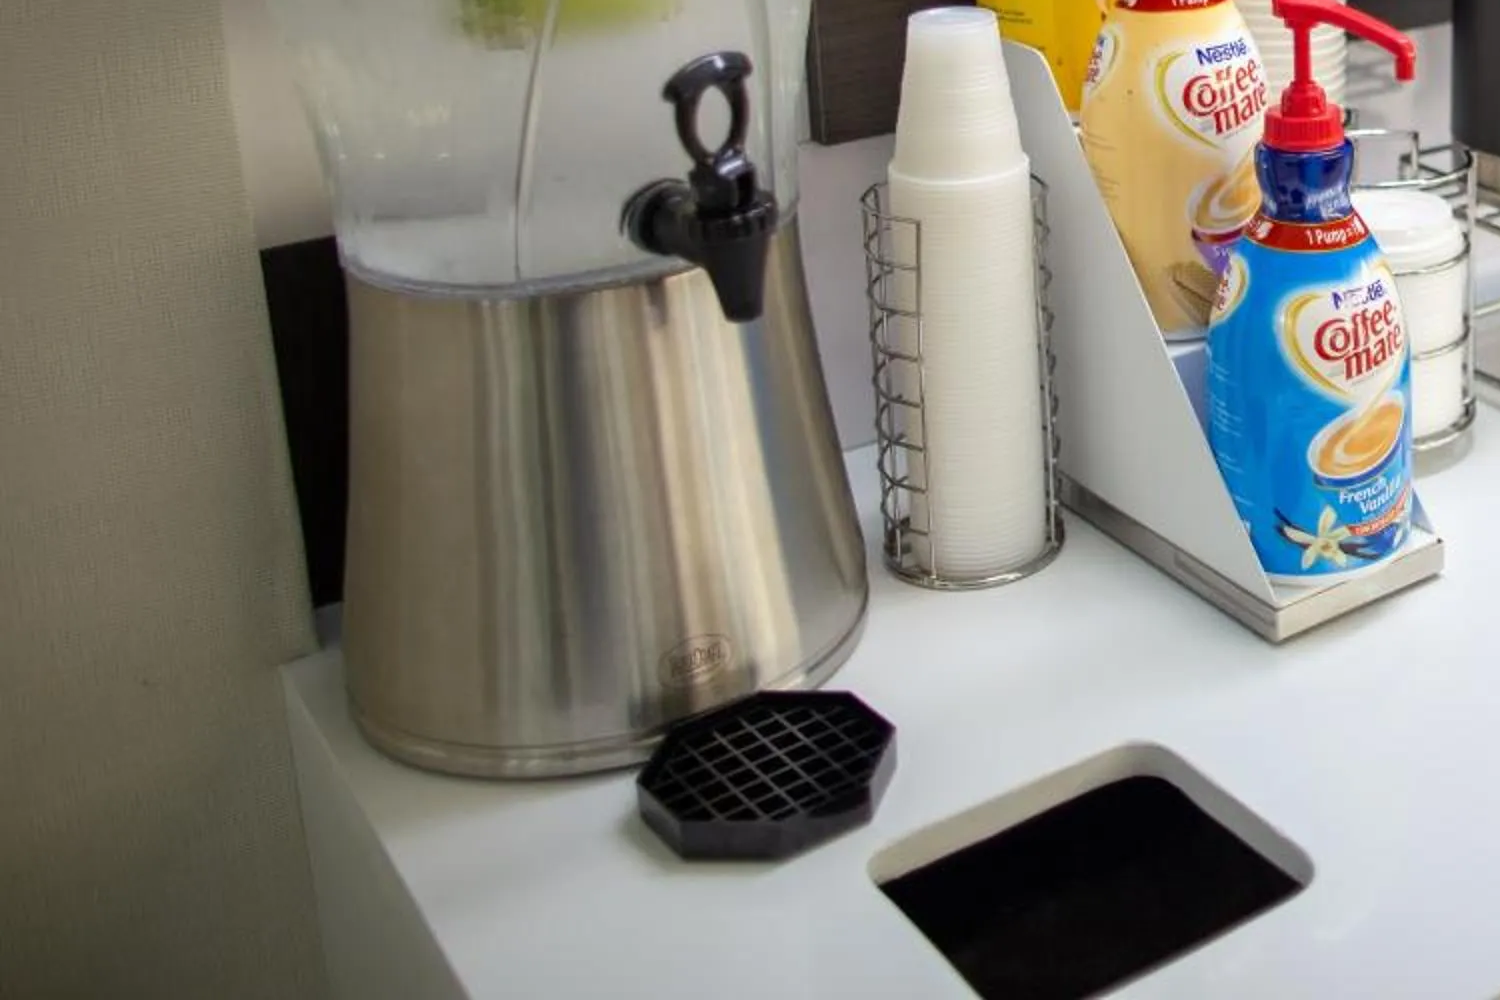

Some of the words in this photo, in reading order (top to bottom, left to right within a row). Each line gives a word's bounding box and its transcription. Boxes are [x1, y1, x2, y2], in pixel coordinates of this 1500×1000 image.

[1195, 37, 1247, 66] Nestlé
[1313, 299, 1394, 362] Coffee
[1343, 323, 1403, 381] mate
